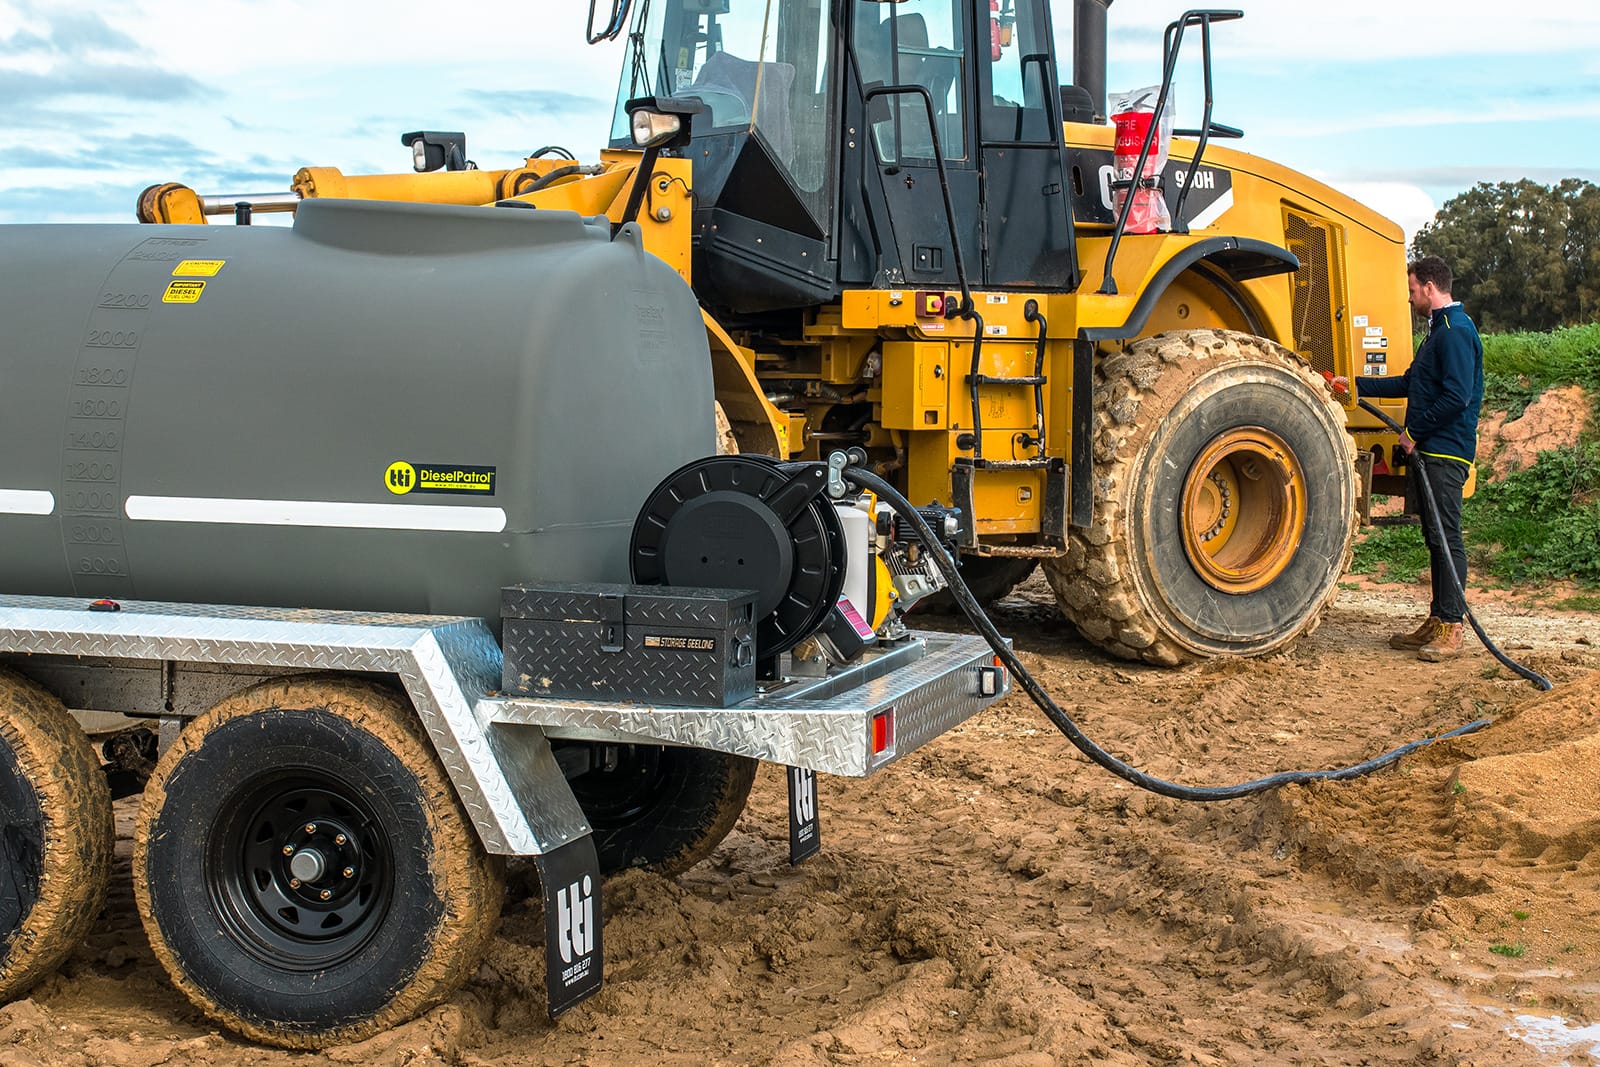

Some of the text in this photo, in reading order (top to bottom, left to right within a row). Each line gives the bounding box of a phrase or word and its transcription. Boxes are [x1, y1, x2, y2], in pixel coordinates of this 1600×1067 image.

[1117, 119, 1136, 131] FIRE
[103, 292, 151, 307] 2200
[88, 329, 138, 346] 2000
[79, 367, 128, 384] 1800
[75, 399, 121, 416] 1600
[70, 431, 118, 448] 1400
[67, 462, 115, 480] 1200
[390, 469, 411, 488] tti
[66, 490, 114, 509] 1000
[72, 526, 114, 542] 800
[79, 556, 121, 573] 600
[660, 637, 687, 648] STORAGE
[687, 638, 715, 649] GEELONG
[557, 874, 594, 964] tti
